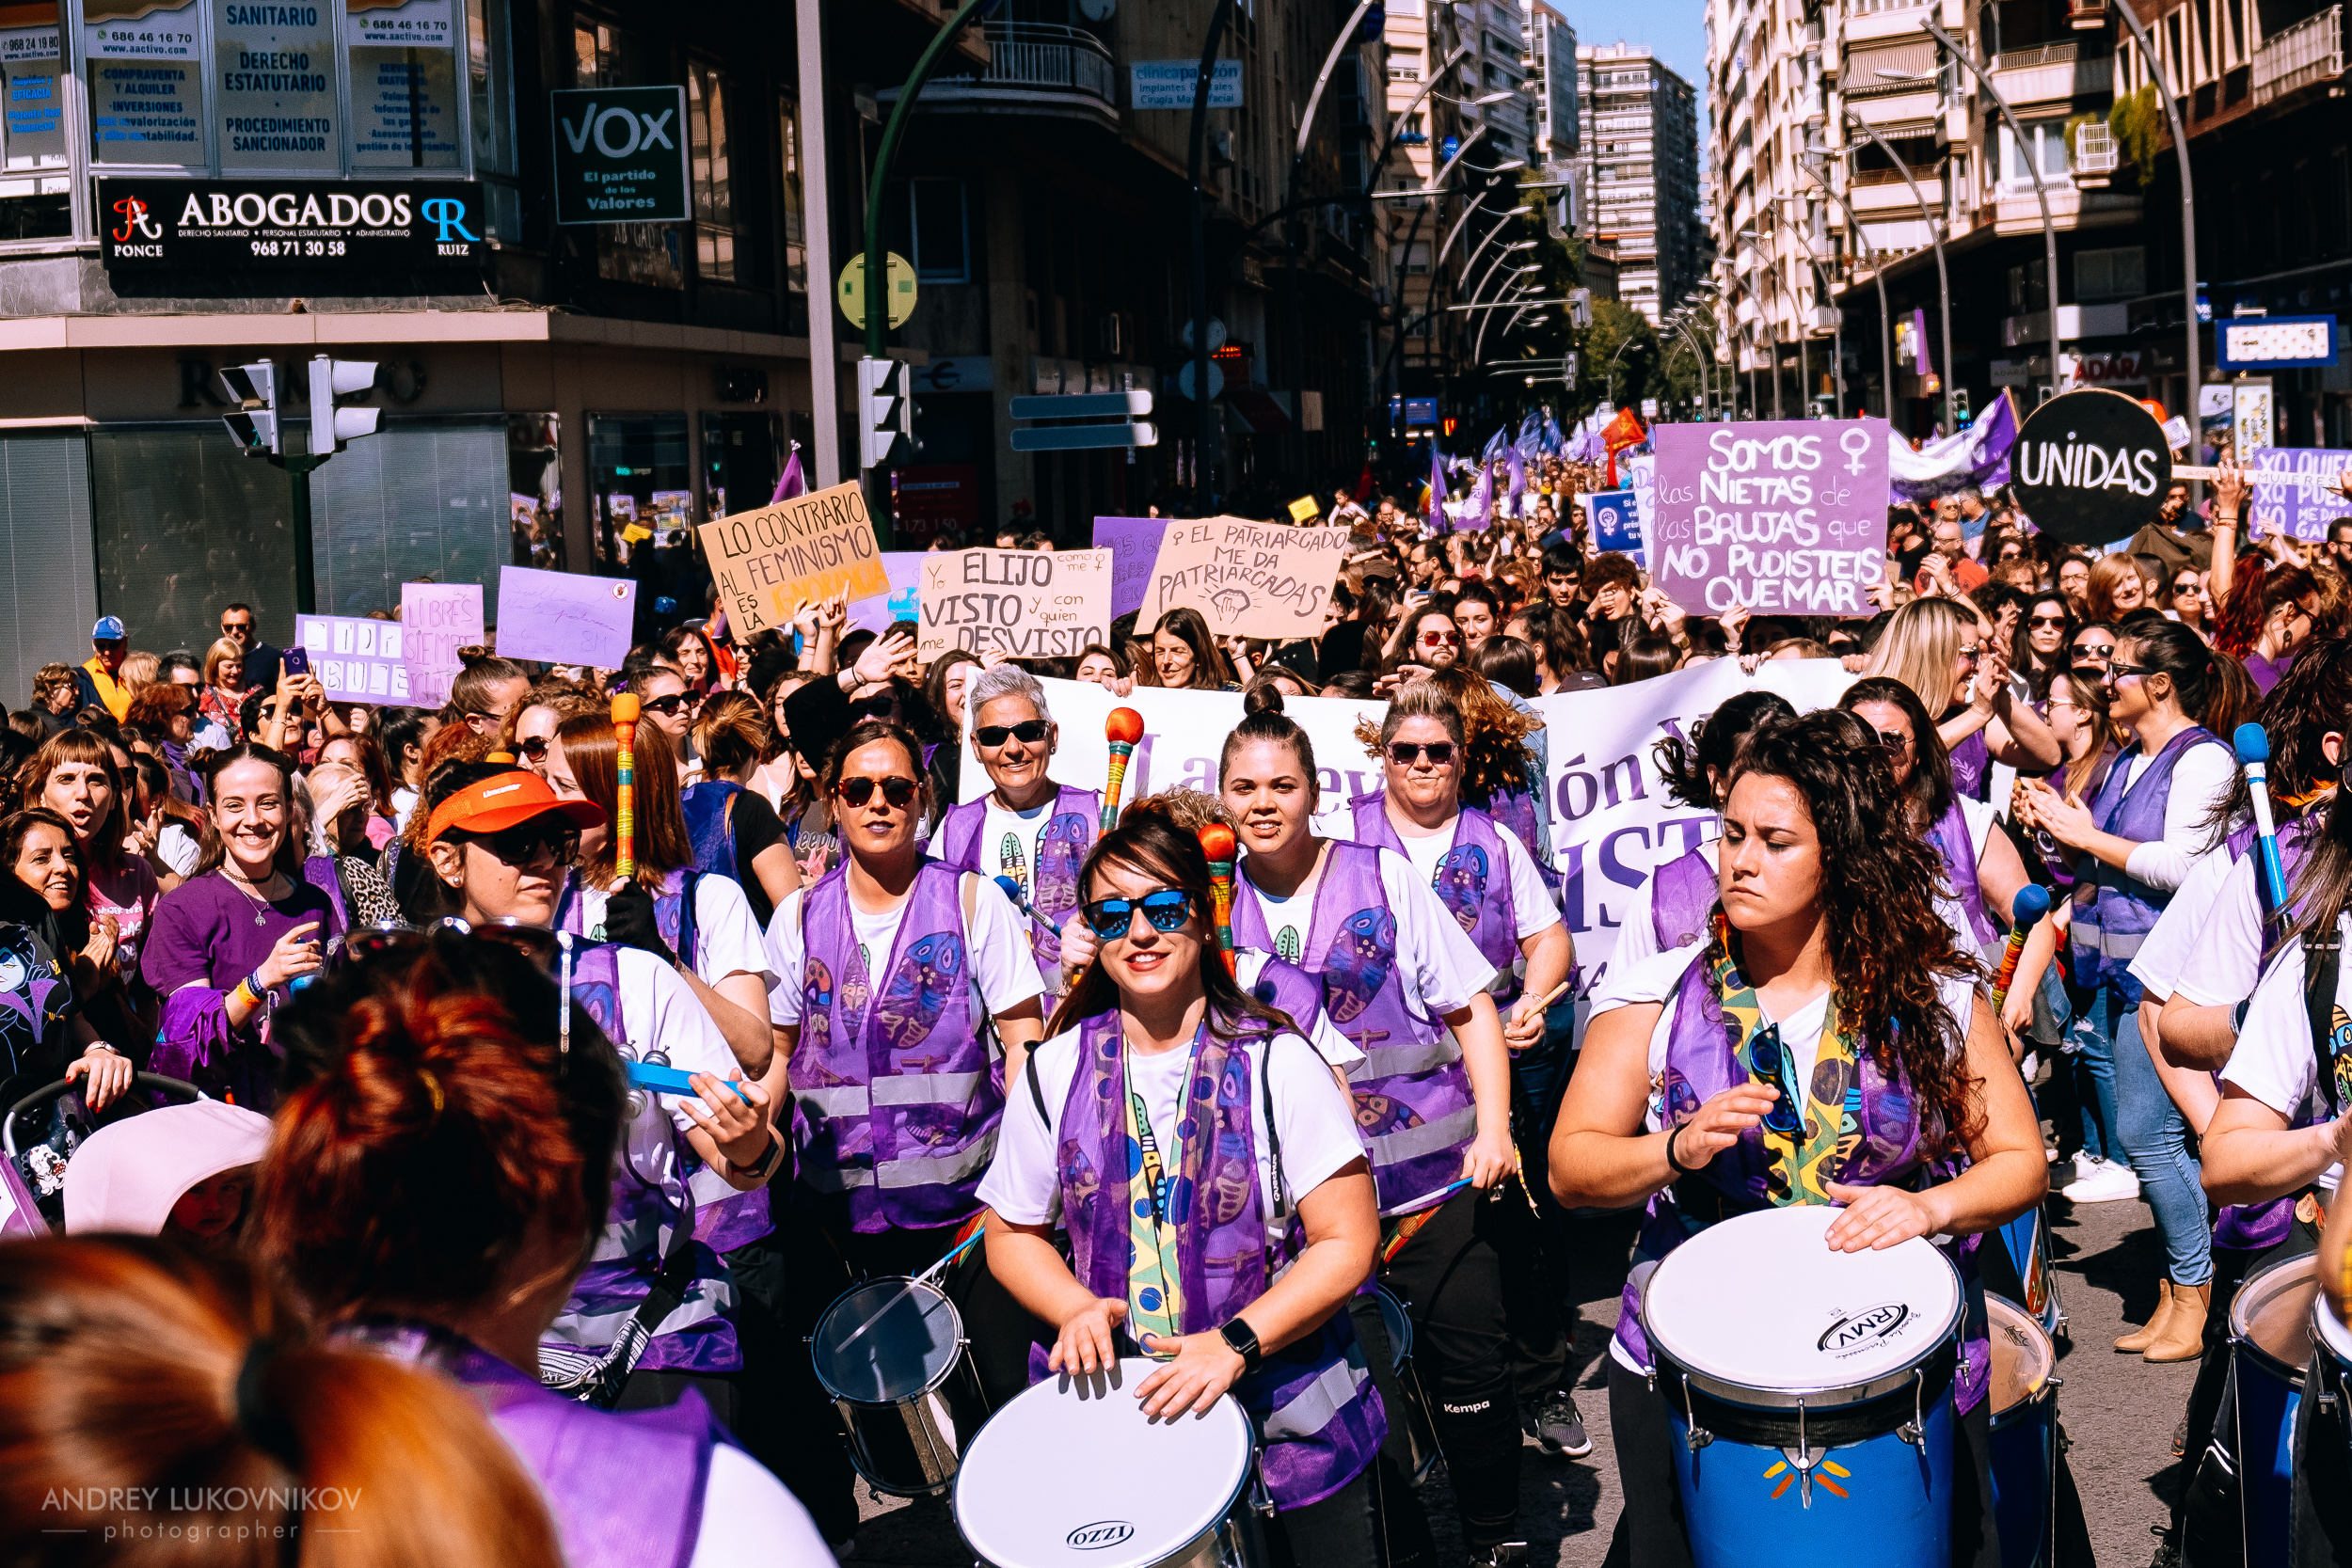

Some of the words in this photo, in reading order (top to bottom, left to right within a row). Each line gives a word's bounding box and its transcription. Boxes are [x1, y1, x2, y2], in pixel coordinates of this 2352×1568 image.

[226, 5, 318, 26] SANITARIO
[397, 20, 412, 30] 46
[415, 20, 430, 31] 16
[433, 21, 448, 31] 70
[8, 38, 24, 52] 968
[25, 37, 36, 50] 24
[38, 36, 48, 50] 19
[48, 35, 59, 48] 80
[111, 31, 135, 42] 686
[138, 32, 154, 43] 46
[158, 32, 173, 43] 16
[177, 33, 192, 44] 70
[102, 43, 188, 55] www.aactivo.com
[239, 51, 310, 71] DERECHO
[103, 69, 185, 81] COMPRAVENTA
[224, 72, 326, 92] ESTATUTARIO
[114, 83, 121, 94] Y
[124, 83, 176, 95] ALQUILER
[1139, 82, 1185, 94] Implantes
[382, 91, 428, 102] Valoraón
[112, 101, 183, 113] INVERSIONES
[374, 103, 426, 114] Informaón
[430, 105, 440, 114] de
[97, 117, 116, 127] con
[119, 116, 196, 128] revalorización
[226, 118, 330, 134] PROCEDIMIENTO
[383, 117, 395, 126] los
[95, 131, 101, 143] y
[371, 129, 437, 139] Asesoramnto
[561, 102, 675, 159] VOX
[232, 135, 326, 152] SANCIONADOR
[356, 142, 388, 152] gestión
[391, 143, 401, 151] de
[405, 142, 416, 151] lo
[583, 171, 598, 182] El
[601, 169, 657, 184] partido
[620, 185, 636, 194] los
[177, 192, 413, 228] ABOGADOS
[586, 196, 657, 211] Valores
[178, 230, 211, 238] DERECHO
[213, 230, 249, 238] SANITARIO
[262, 230, 297, 238] PERSONAL
[298, 230, 342, 238] ESTATUTARIO
[356, 230, 410, 238] ADMINISTRATIVO
[114, 244, 164, 258] PONCE
[250, 240, 279, 257] 968
[282, 241, 301, 256] 71
[305, 240, 325, 256] 30
[326, 240, 346, 257] 58
[437, 243, 469, 256] RUIZ
[2258, 472, 2337, 487] MUJERES
[1657, 473, 1693, 505] las
[1699, 470, 1813, 506] NIETAS
[1820, 475, 1851, 506] de
[2297, 507, 2319, 522] ME
[718, 521, 753, 559] LO
[755, 491, 865, 548] CONTRARIO
[1658, 512, 1692, 543] las
[1692, 505, 1820, 546] BRUJAS
[1827, 518, 1872, 547] que
[1190, 525, 1215, 544] EL
[1224, 524, 1348, 551] PATRIARCADO
[720, 568, 747, 600] AL
[745, 525, 873, 591] FEMINISMO
[1057, 552, 1092, 563] como
[1214, 546, 1245, 565] ME
[1253, 551, 1279, 569] DA
[1661, 544, 1709, 582] NO
[1728, 544, 1883, 584] PUDISTEIS
[927, 563, 946, 591] Yo
[962, 551, 1053, 588] ELIJO
[1067, 562, 1087, 572] me
[771, 561, 890, 619] IGNORANCIA
[1159, 563, 1327, 618] PATRIARCADAS
[1704, 575, 1860, 612] QUEMAR
[737, 594, 758, 615] ES
[922, 593, 1023, 627] VISTO
[1028, 595, 1042, 615] y
[1054, 594, 1084, 606] con
[741, 611, 766, 632] LA
[1040, 608, 1078, 628] quien
[919, 637, 946, 652] me
[957, 626, 1103, 657] DESVISTO
[1271, 1153, 1281, 1202] Quechua
[1837, 1307, 1895, 1348] RMV
[1443, 1400, 1490, 1414] Kempa
